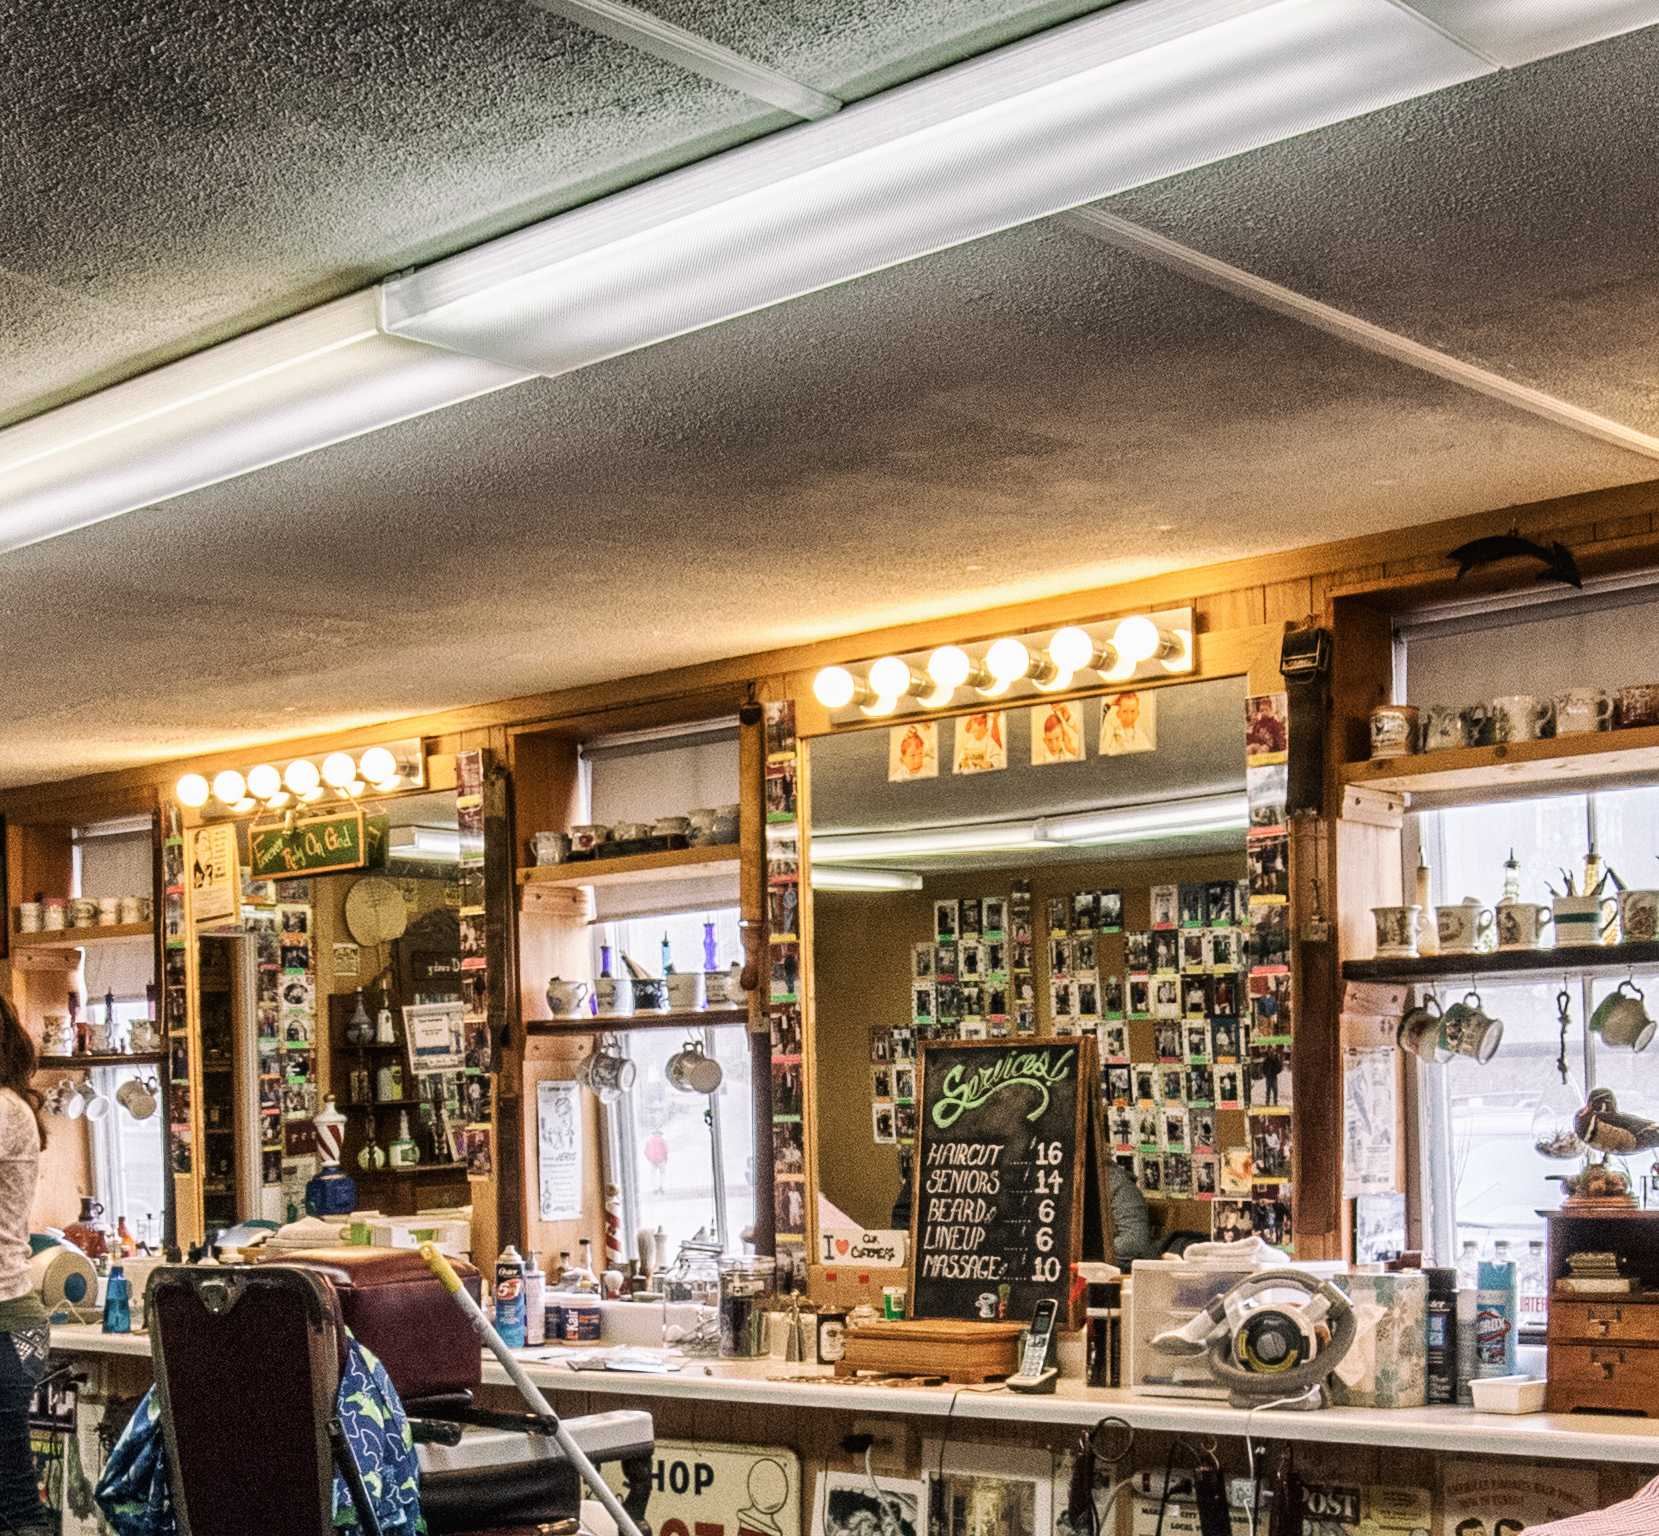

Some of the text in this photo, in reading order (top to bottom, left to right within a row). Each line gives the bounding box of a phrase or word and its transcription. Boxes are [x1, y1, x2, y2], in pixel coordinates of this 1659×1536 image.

[323, 825, 353, 851] God
[926, 1142, 1005, 1167] HAIRCUT
[925, 1169, 1001, 1195] SENIORS
[822, 1234, 834, 1261] I
[923, 1225, 986, 1251] LINEUP
[922, 1254, 1002, 1280] MASSAGE
[1301, 1485, 1360, 1519] OST
